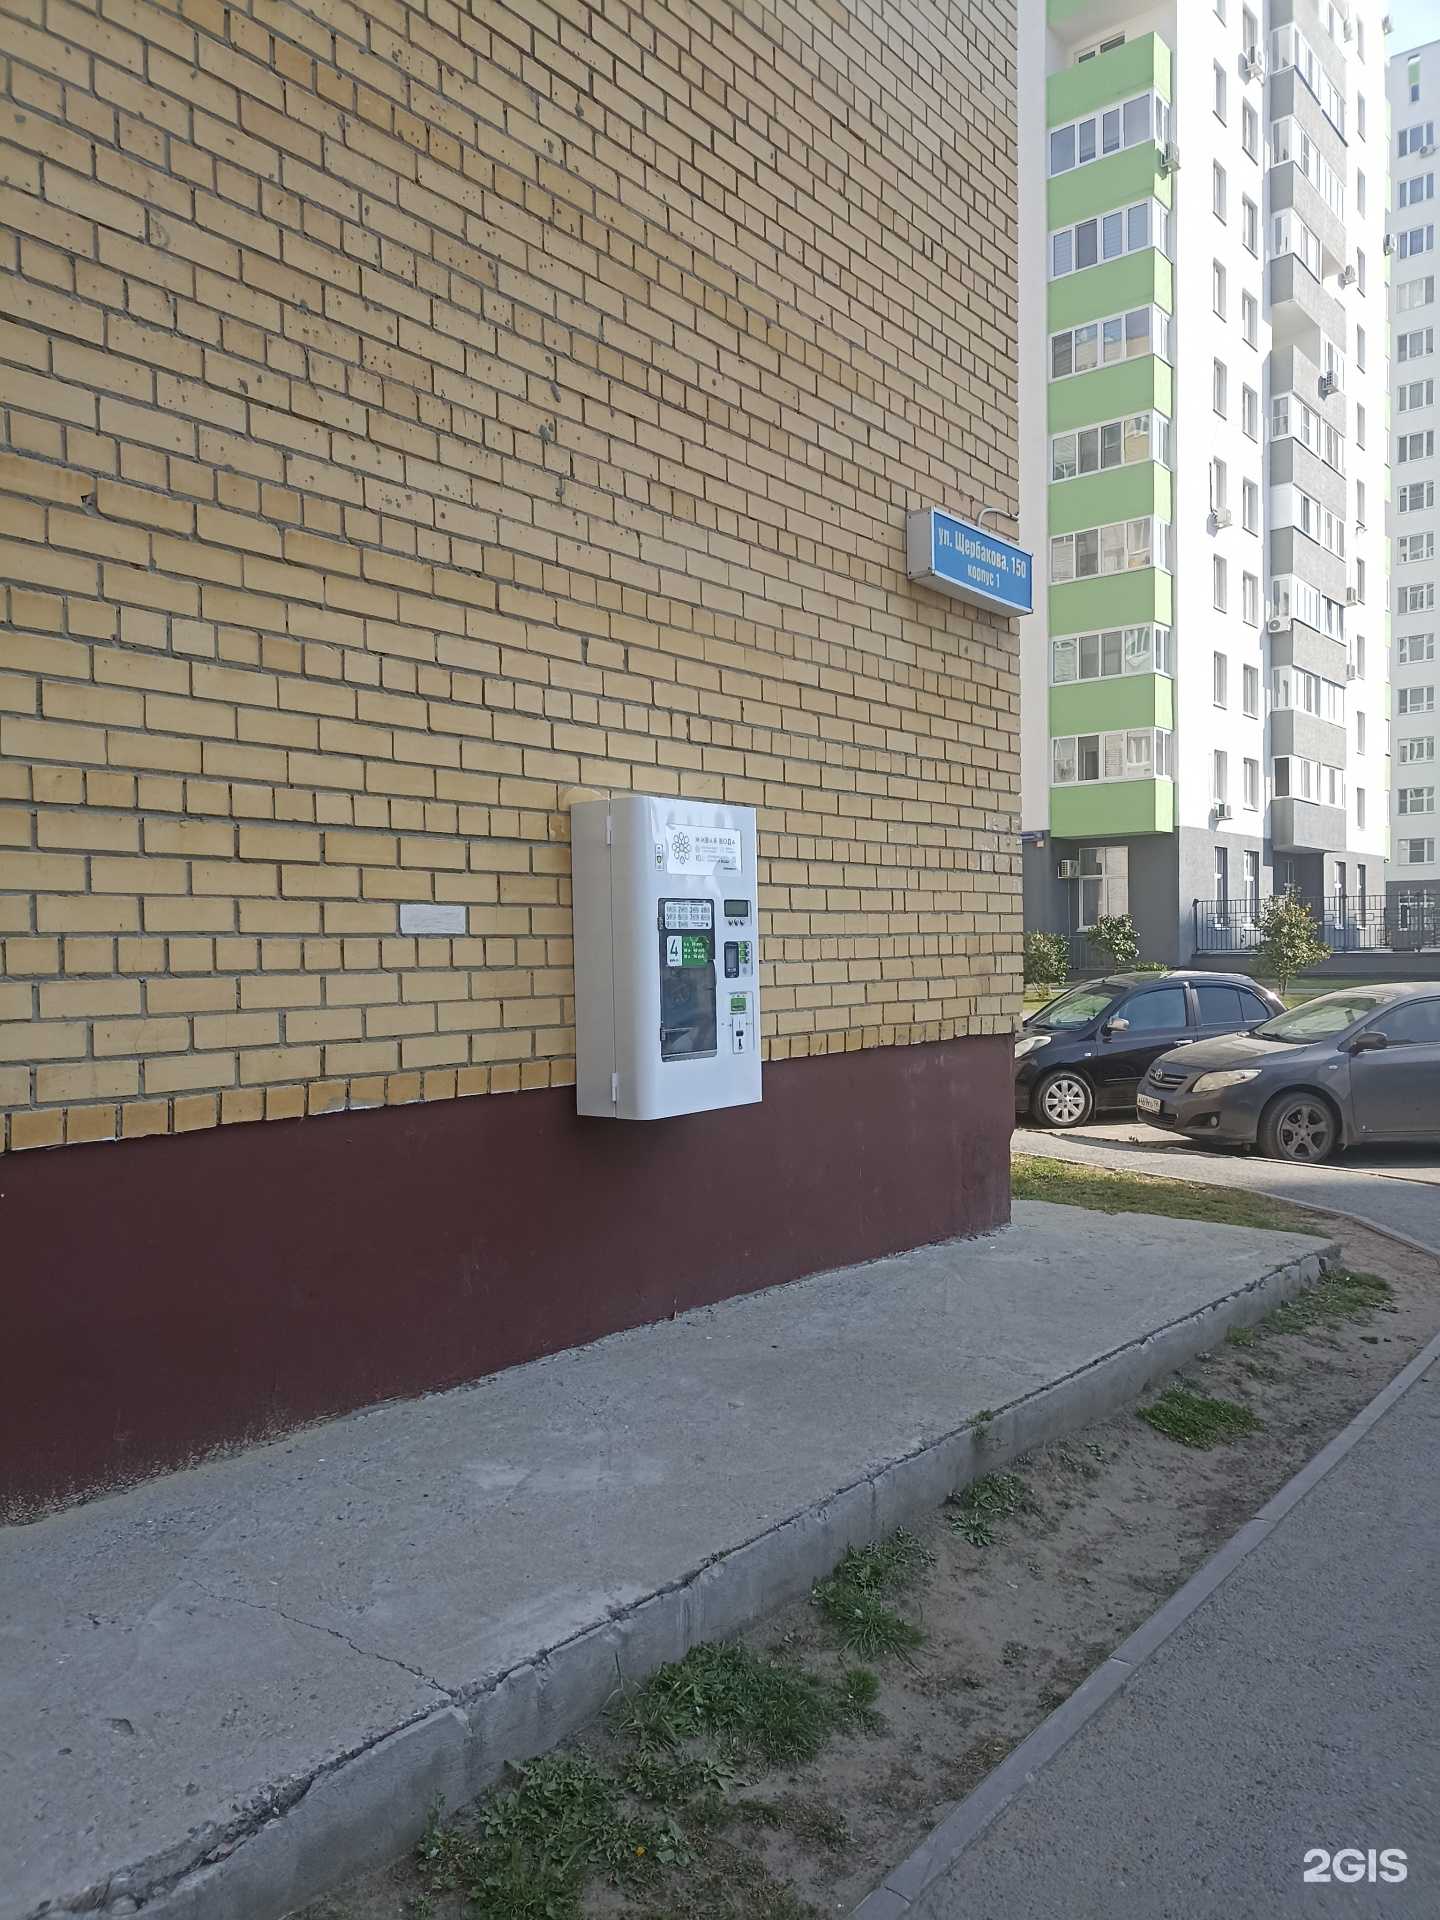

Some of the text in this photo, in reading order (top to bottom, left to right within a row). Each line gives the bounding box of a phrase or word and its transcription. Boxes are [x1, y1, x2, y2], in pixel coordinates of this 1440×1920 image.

[938, 528, 1027, 578] ул. Щербакова, 150
[967, 563, 1000, 588] корпус 1
[670, 939, 678, 956] 4
